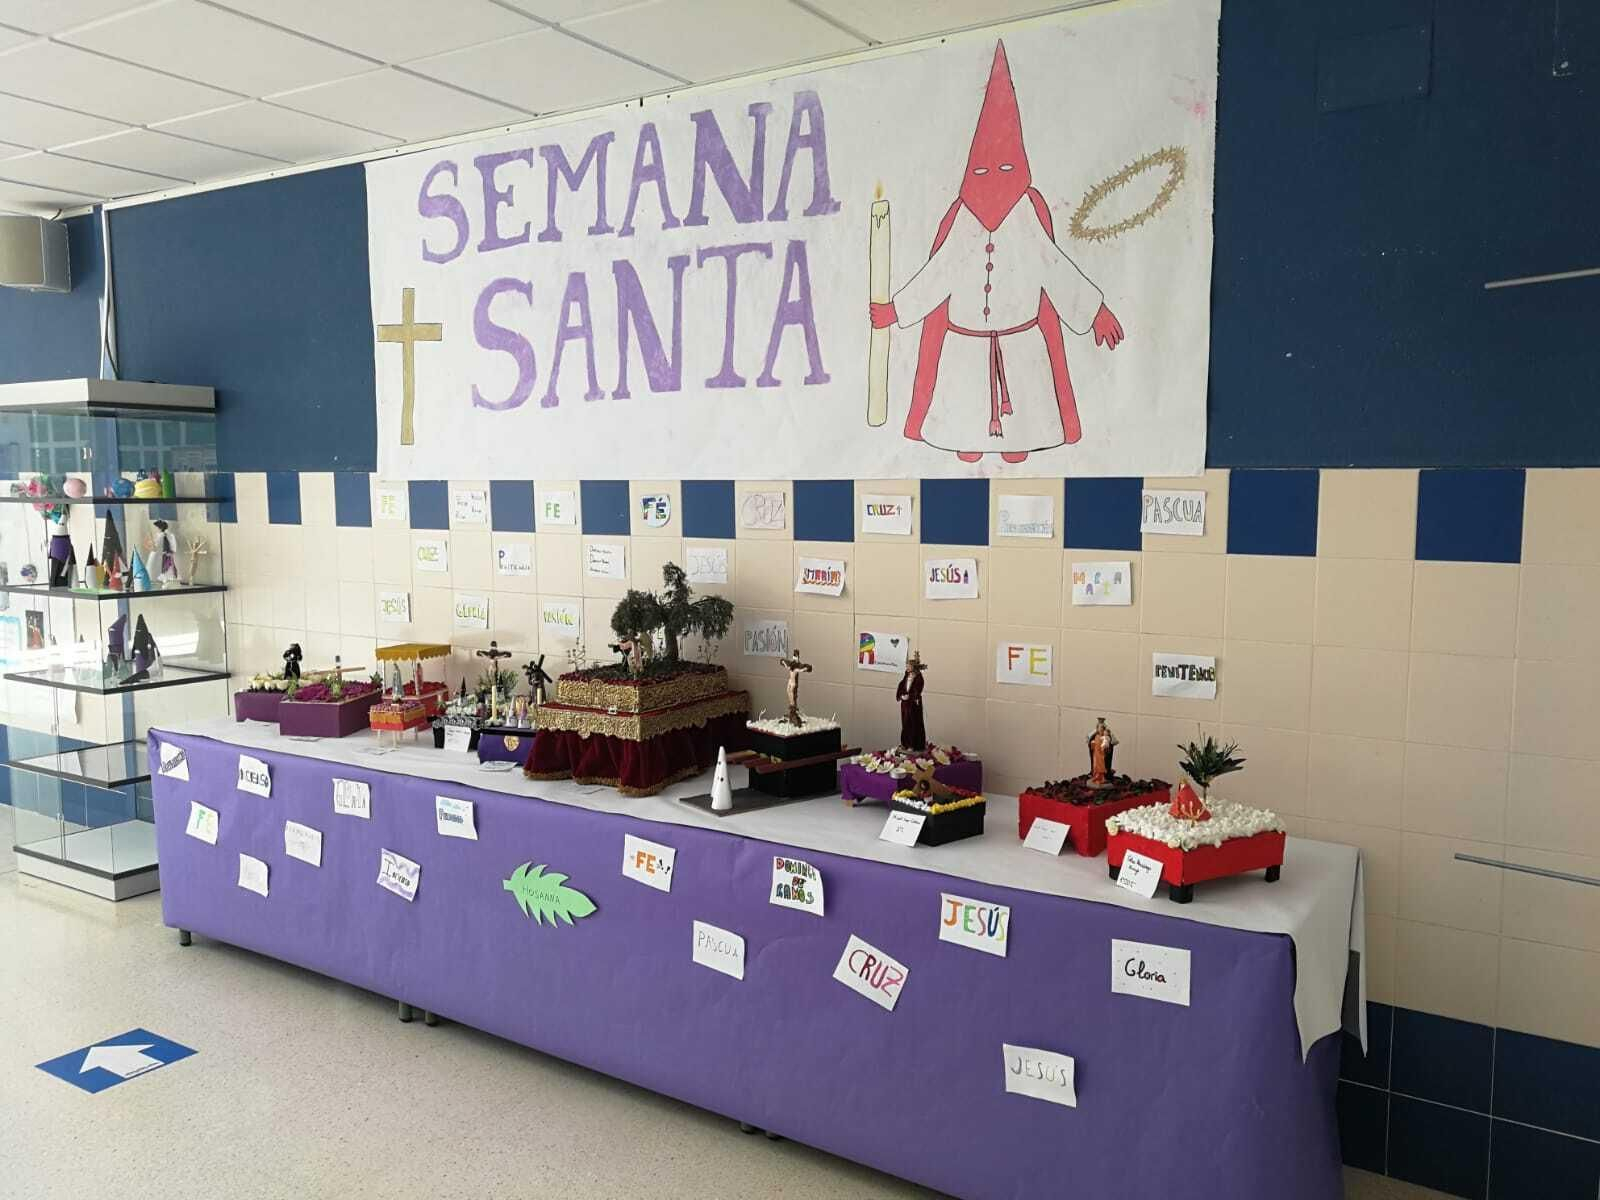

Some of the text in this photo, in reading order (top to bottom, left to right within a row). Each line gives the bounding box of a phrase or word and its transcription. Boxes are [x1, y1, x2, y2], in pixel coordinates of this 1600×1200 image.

[418, 90, 841, 264] SEMANA
[472, 240, 831, 411] SANTA
[545, 502, 561, 519] FE
[642, 497, 667, 520] FÉ
[867, 504, 896, 516] CRUZ
[1142, 495, 1203, 524] PASCUA
[929, 564, 961, 584] JESÚS
[1007, 646, 1048, 676] FE
[522, 885, 561, 905] HOSANNA
[943, 900, 1009, 941] JESÚS
[848, 948, 904, 998] CRUZ
[1124, 957, 1168, 985] Gloria
